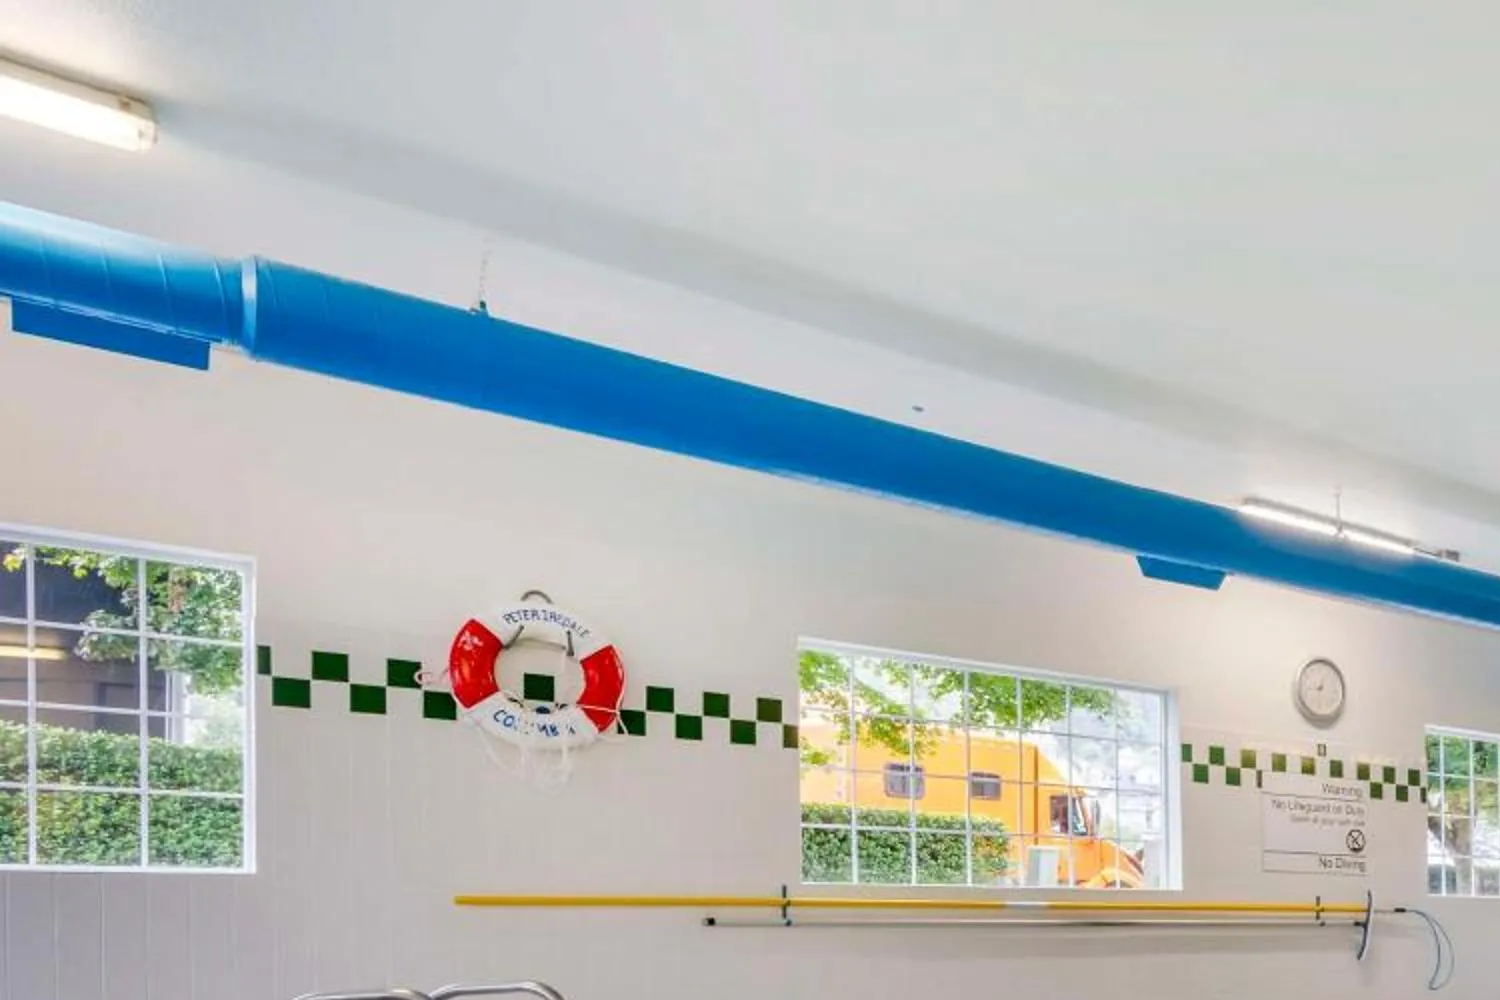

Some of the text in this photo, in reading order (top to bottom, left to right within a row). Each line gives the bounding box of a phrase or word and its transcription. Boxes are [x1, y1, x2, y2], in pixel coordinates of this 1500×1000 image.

[1322, 783, 1363, 798] Warning
[1319, 856, 1366, 873] No Diving
